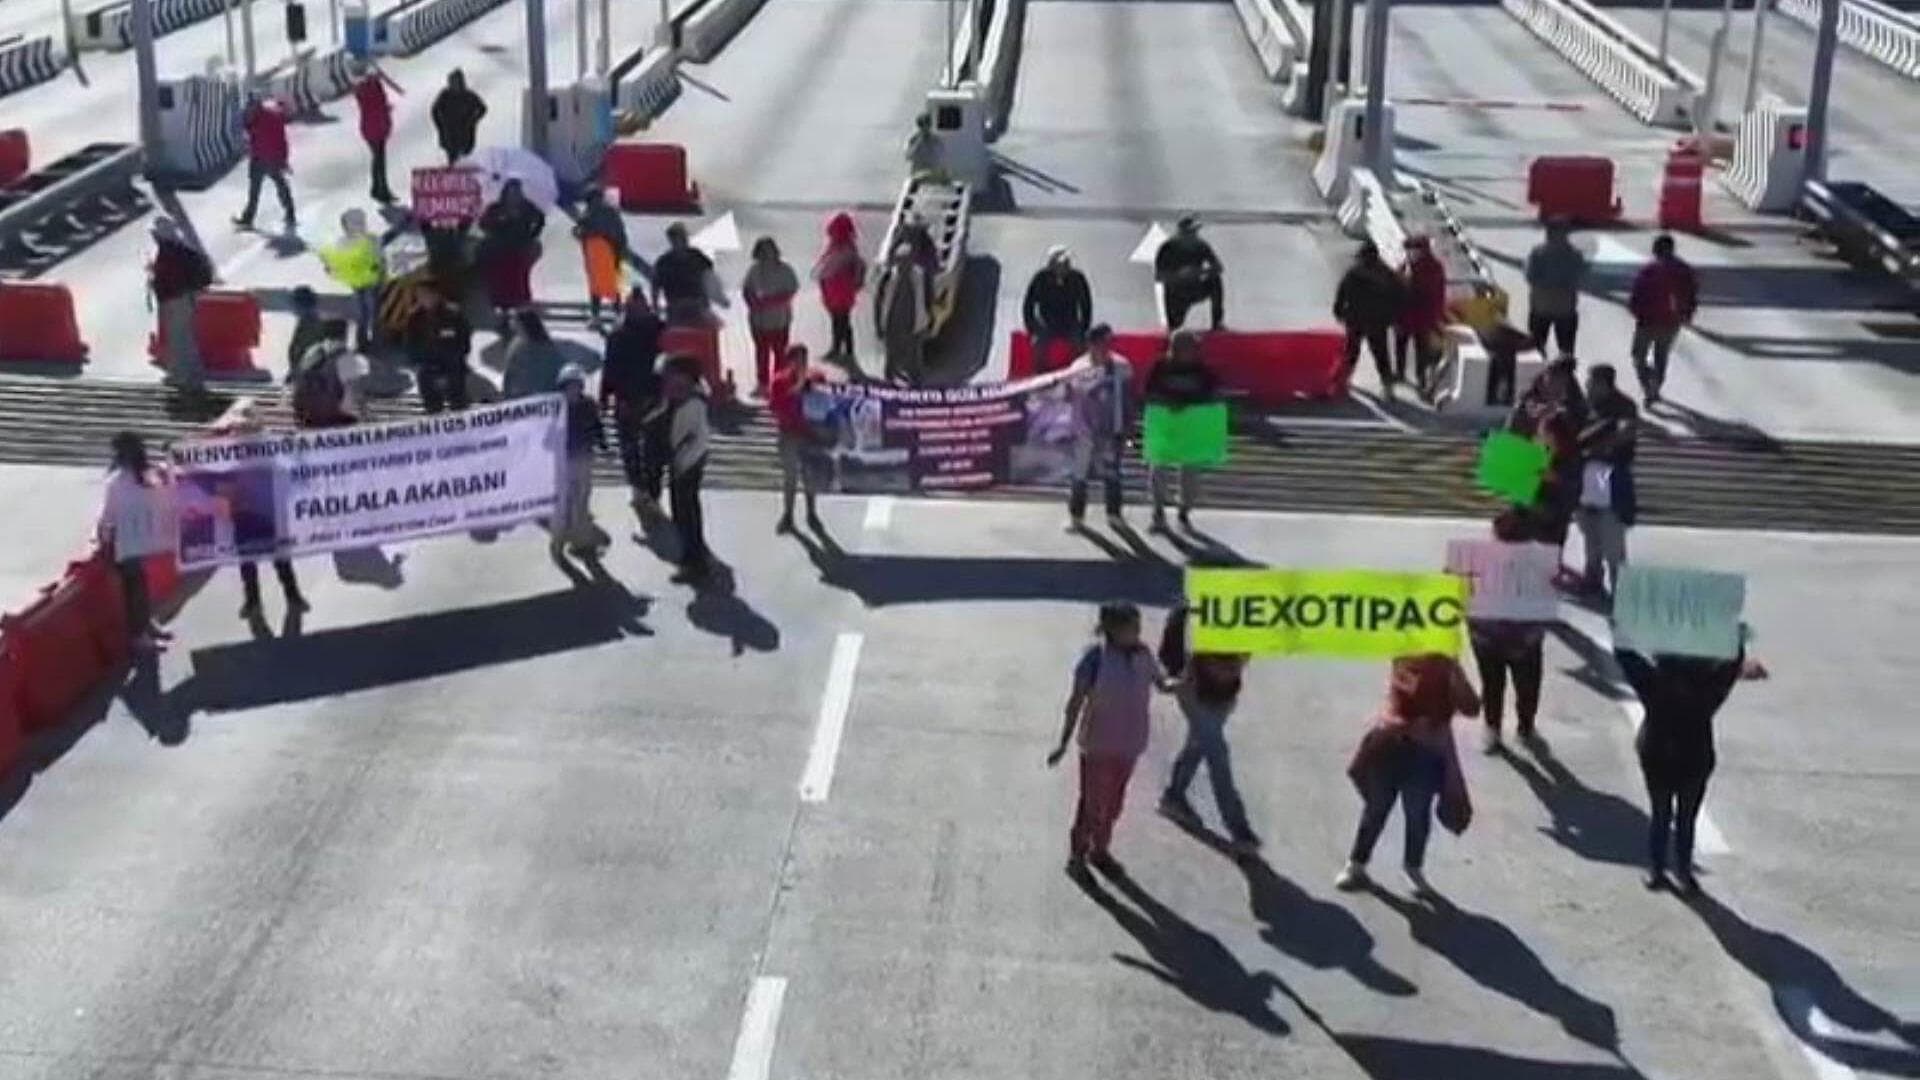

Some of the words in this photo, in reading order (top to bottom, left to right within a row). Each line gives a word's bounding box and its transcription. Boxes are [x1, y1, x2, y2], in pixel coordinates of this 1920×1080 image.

[295, 488, 399, 520] FADLALA
[404, 470, 508, 504] AKABANI
[1185, 593, 1463, 631] HUEXOTIPAC
